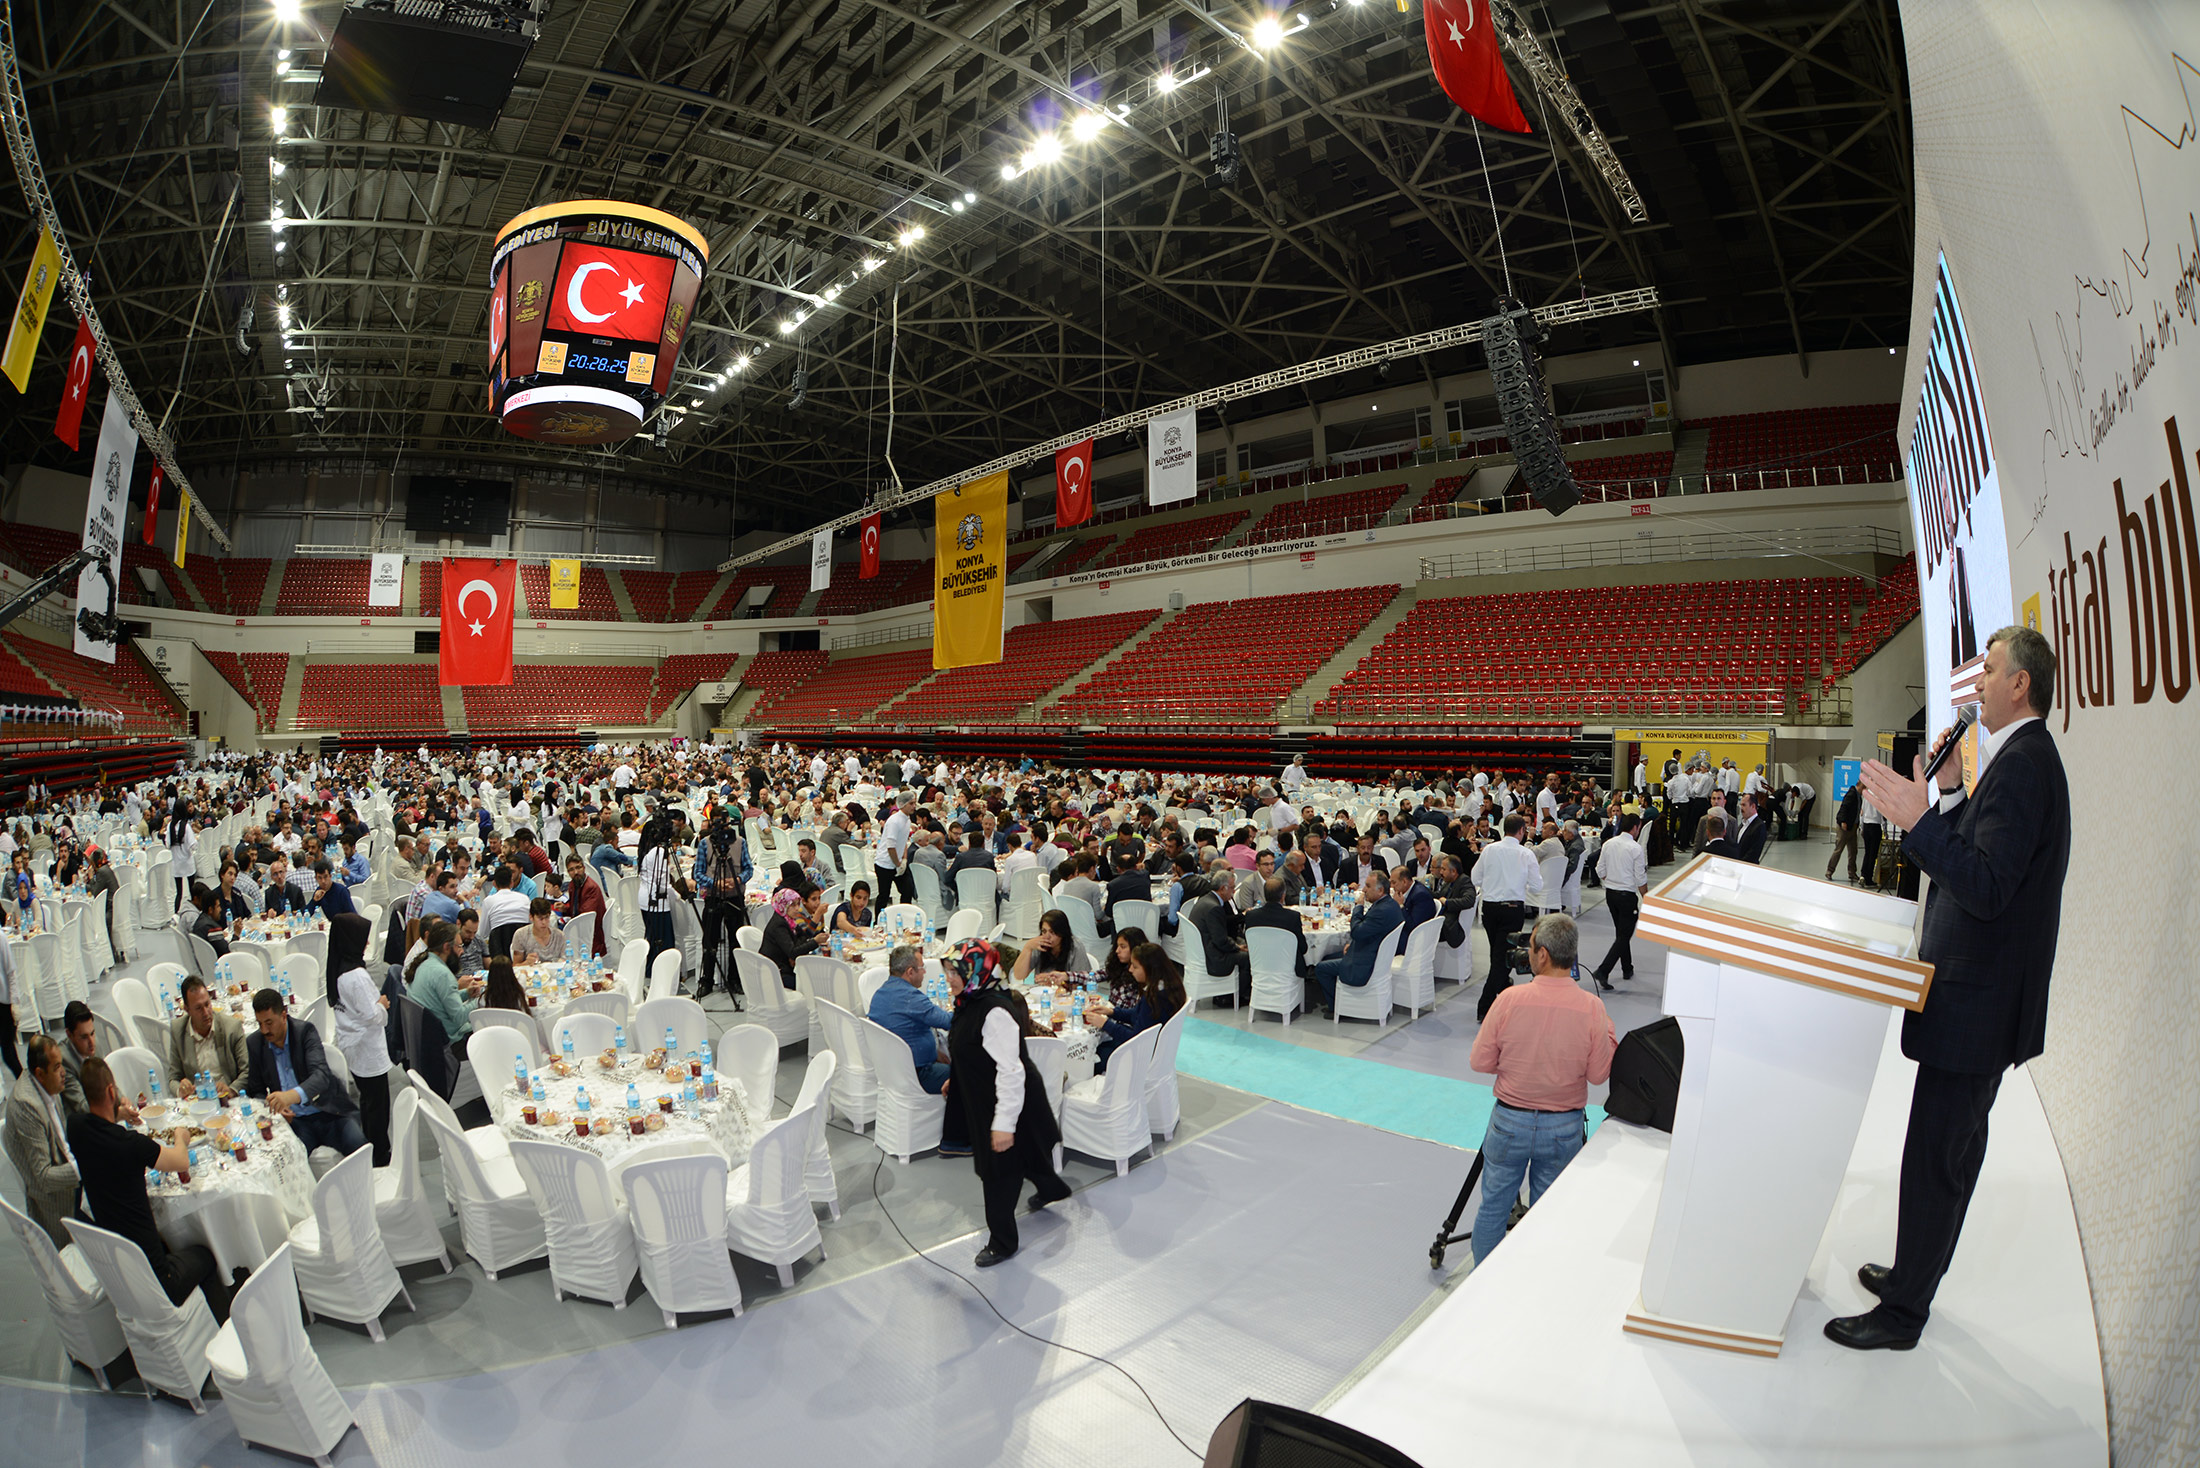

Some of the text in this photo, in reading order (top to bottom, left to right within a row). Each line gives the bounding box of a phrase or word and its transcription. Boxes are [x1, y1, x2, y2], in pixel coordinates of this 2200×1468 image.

[586, 219, 682, 257] BÜYÜKŞEHİR
[567, 353, 629, 375] 20:28:25
[1154, 450, 1193, 467] BÜYÜKŞEHİR
[1163, 446, 1183, 456] KONYA
[100, 503, 115, 530] KONYA
[956, 553, 984, 571] KONYA
[1069, 573, 1096, 584] Konya'yı
[1096, 567, 1122, 580] Geçmişi
[1123, 564, 1144, 575] Kadar
[1145, 559, 1170, 572] Büyük,
[1171, 552, 1207, 567] Görkemli
[1208, 551, 1220, 562] Bir
[1221, 545, 1260, 560] Geleceğe
[1261, 540, 1318, 554] Hazırlıyoruz.
[942, 563, 998, 590] BÜYÜKŞEHİR
[953, 582, 987, 599] BELEDİYESİ
[1665, 731, 1703, 740] BÜYÜKŞEHİR
[1704, 732, 1738, 740] BELEDİYESİ
